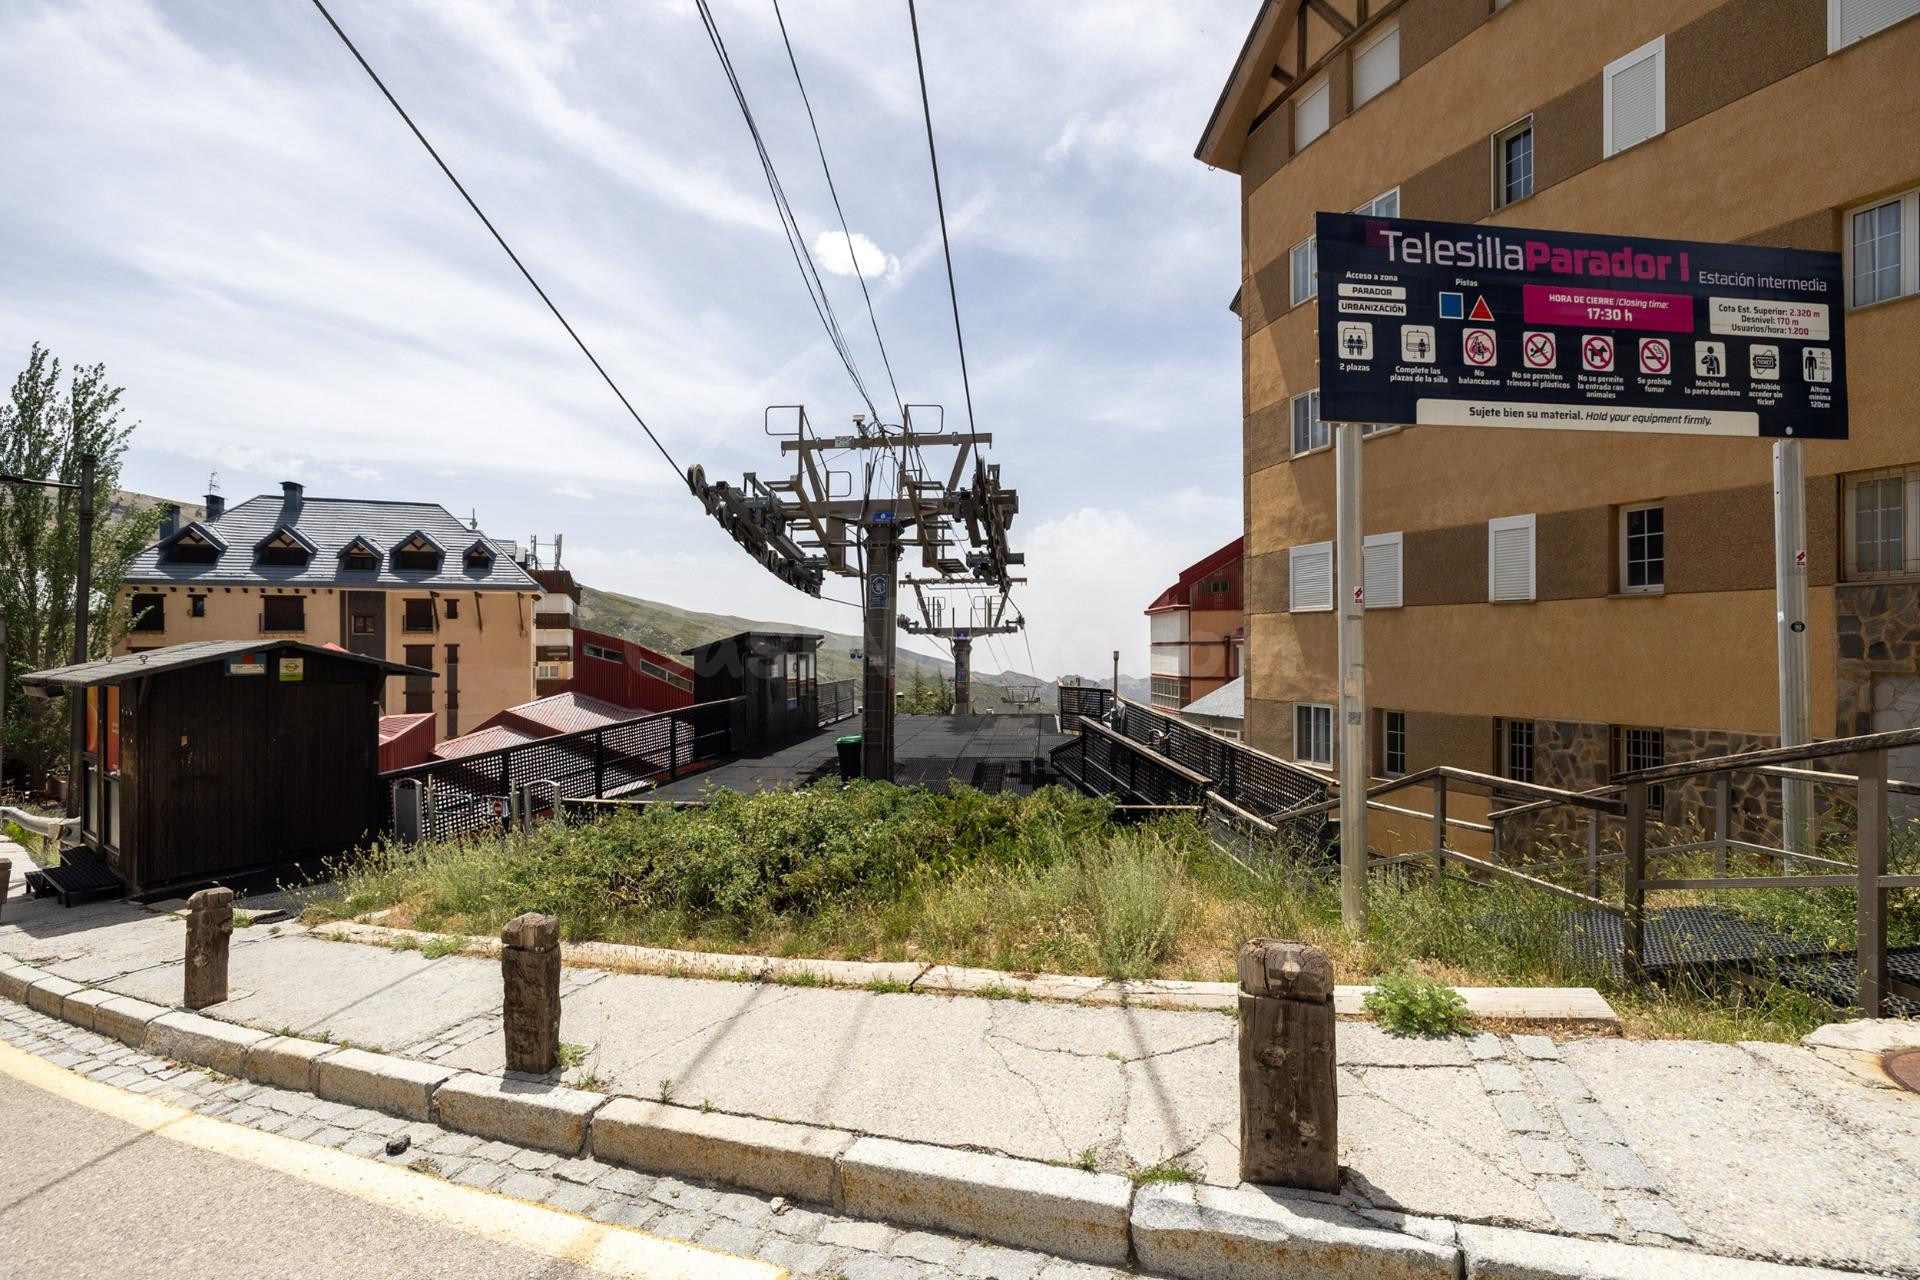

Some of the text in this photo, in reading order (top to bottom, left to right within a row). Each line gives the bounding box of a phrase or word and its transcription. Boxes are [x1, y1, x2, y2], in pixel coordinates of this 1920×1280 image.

[1346, 271, 1372, 279] Acceso
[1456, 278, 1477, 287] Pistas
[1699, 272, 1827, 291] Estación intermedia
[1352, 287, 1392, 296] PARADOR
[1549, 294, 1572, 302] HORA
[1574, 295, 1584, 303] DE
[1586, 296, 1614, 305] CIERRE
[1649, 300, 1668, 309] time:
[1342, 303, 1404, 312] URBANIZACIÓN
[1718, 304, 1735, 313] Cota
[1754, 306, 1788, 316] Superior:
[1789, 308, 1811, 317] 2.320
[1587, 308, 1632, 321] 17:30 h
[1741, 315, 1775, 324] Desnivel:
[1732, 324, 1787, 334] Usuarios/hora:
[1346, 363, 1370, 372] plazas
[1395, 366, 1429, 374] Complete
[1390, 373, 1413, 382] plazas
[1458, 376, 1500, 386] balancearse
[1532, 373, 1563, 381] permiten
[1696, 380, 1720, 388] Mochila
[1710, 388, 1740, 396] delantera
[1469, 406, 1712, 426] Sujete bien su material. Hold your equipment firmly.
